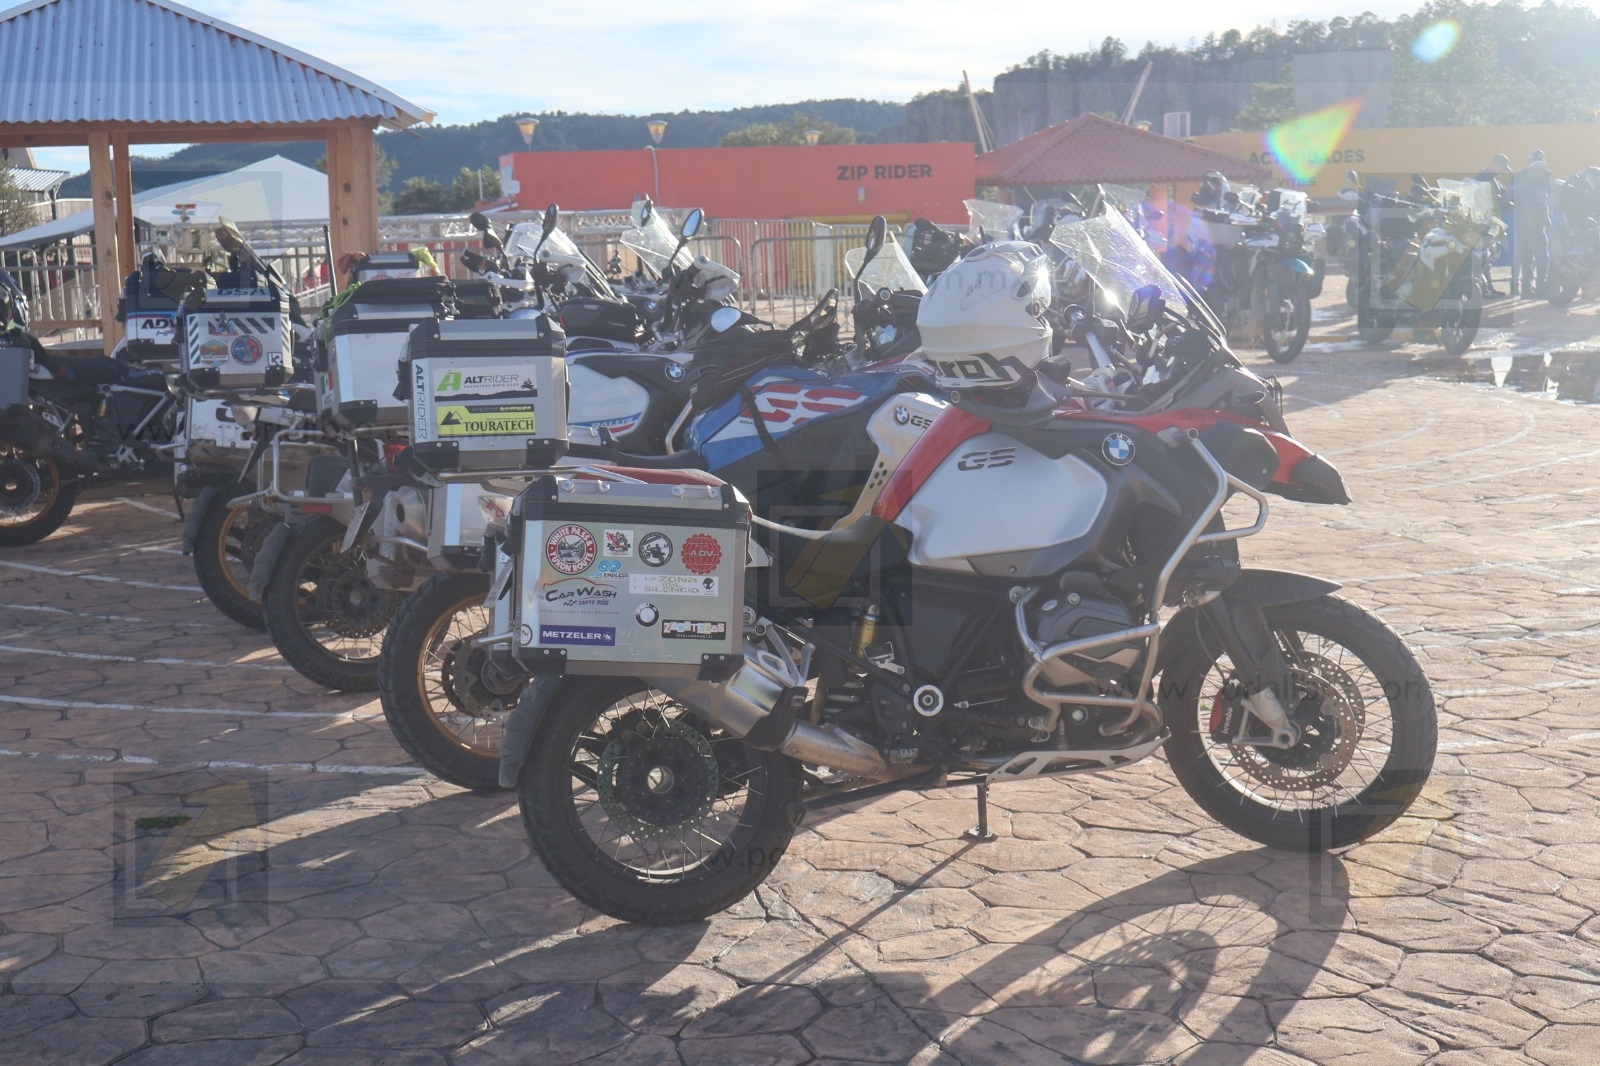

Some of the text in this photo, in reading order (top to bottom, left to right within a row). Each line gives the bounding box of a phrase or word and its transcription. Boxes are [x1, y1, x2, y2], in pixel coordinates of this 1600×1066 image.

[1249, 149, 1365, 166] ACTVIDADES
[836, 164, 932, 181] ZIP RIDER
[464, 374, 519, 384] ALTRIDER
[415, 364, 428, 440] ALTRIDER
[463, 420, 534, 432] TOURATECH
[957, 447, 1017, 471] GS
[549, 527, 571, 545] WHITE
[570, 527, 590, 541] PASS
[549, 551, 594, 572] YUKON ROUTE
[689, 550, 715, 558] ADV
[542, 630, 602, 640] METZELER
[1220, 707, 1233, 734] brembo
